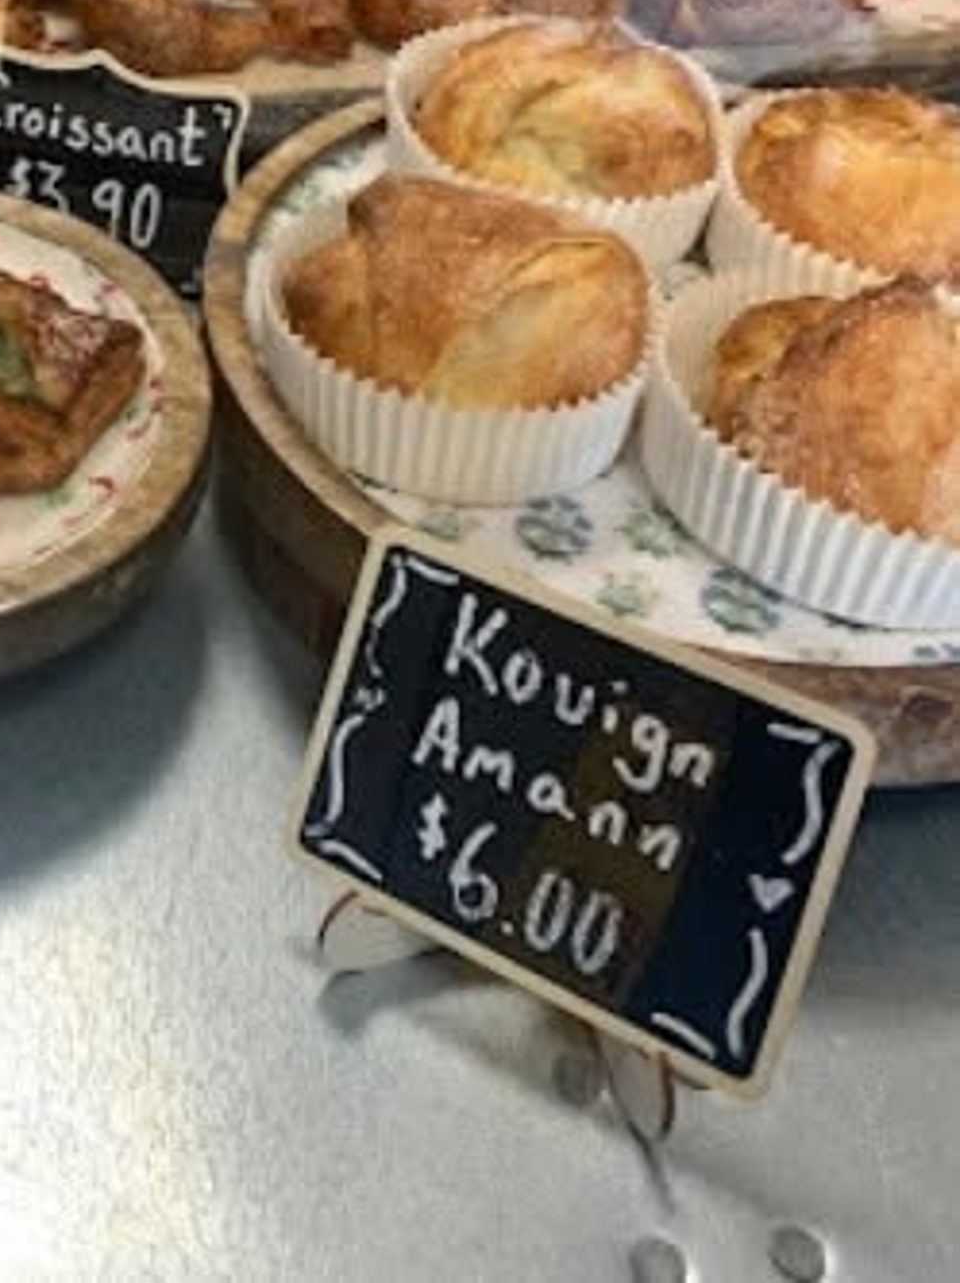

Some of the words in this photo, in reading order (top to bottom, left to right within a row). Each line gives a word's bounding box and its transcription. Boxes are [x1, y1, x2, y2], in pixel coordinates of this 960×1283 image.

[4, 157, 162, 248] $390
[444, 592, 716, 793] Kouign
[411, 697, 684, 872] Amann
[417, 794, 622, 975] $6.00
